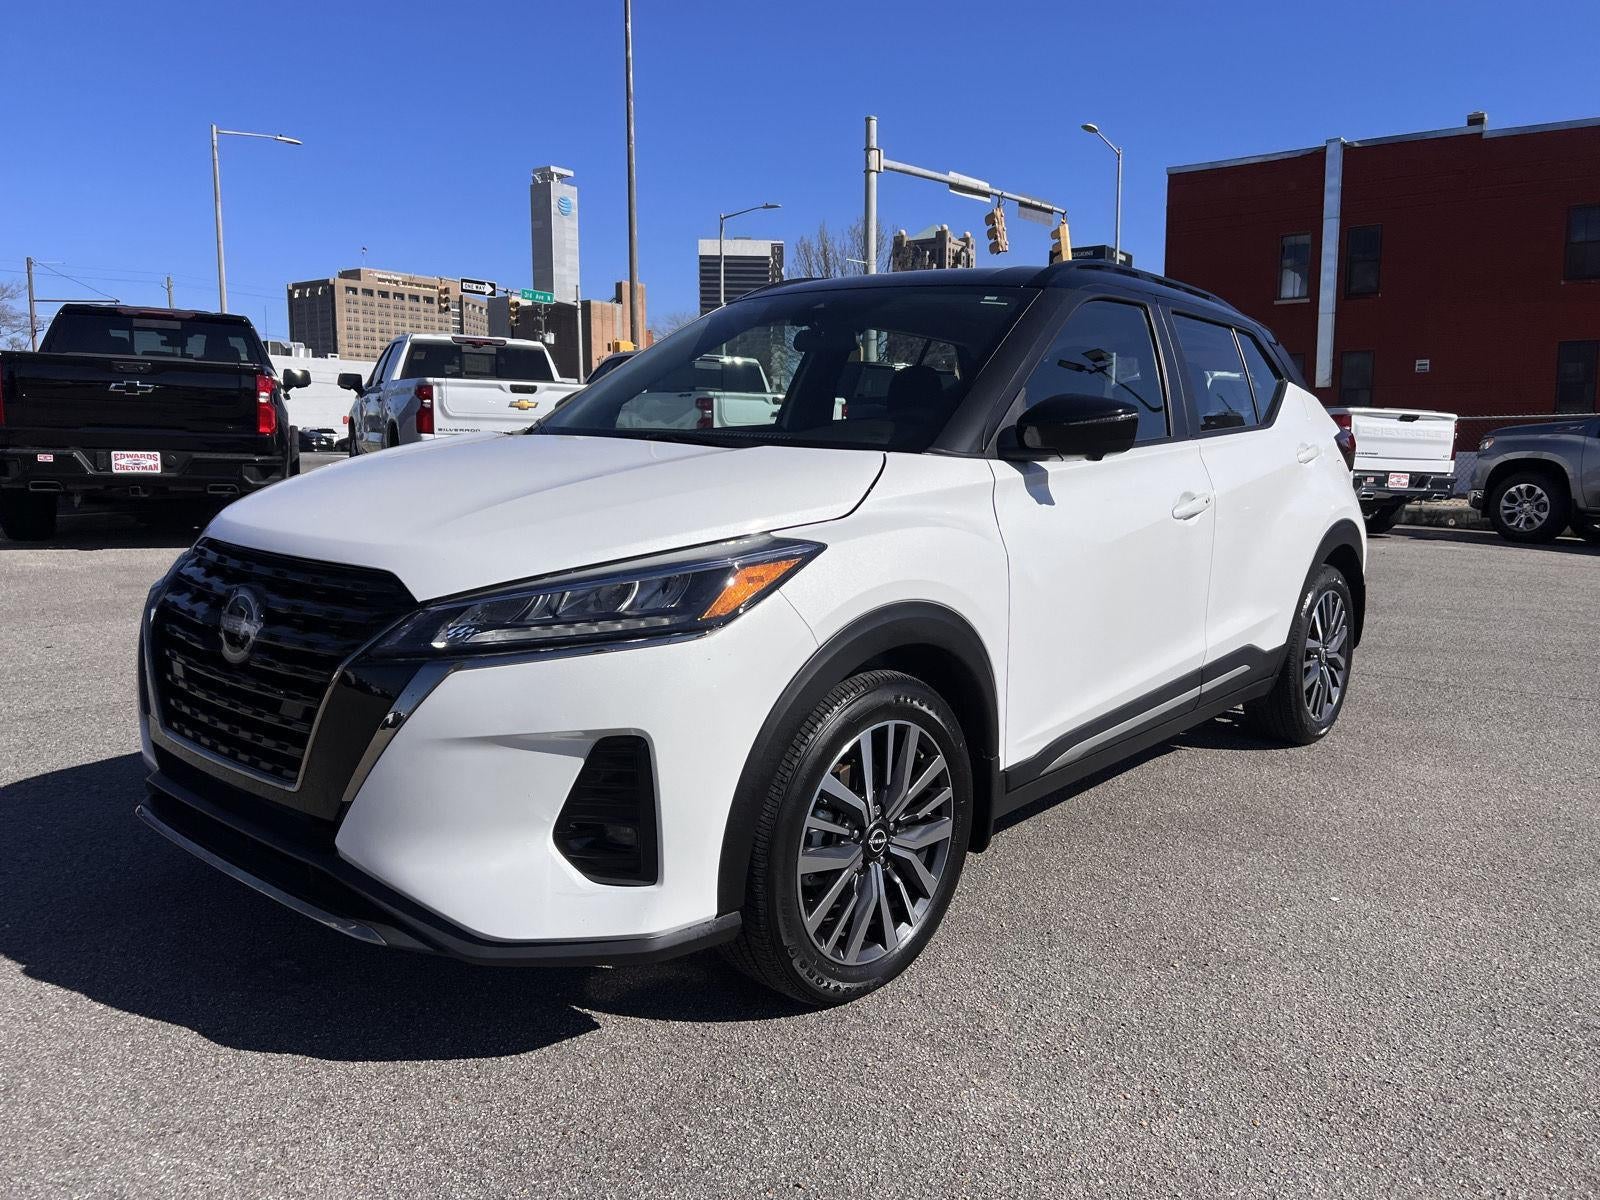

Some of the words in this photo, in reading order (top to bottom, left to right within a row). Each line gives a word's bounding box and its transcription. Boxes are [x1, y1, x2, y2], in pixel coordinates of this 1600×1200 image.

[523, 291, 533, 299] 3rd
[1361, 427, 1448, 440] CHEVROLE
[113, 453, 158, 462] EDWARDS
[114, 462, 159, 471] CHEVYMAN
